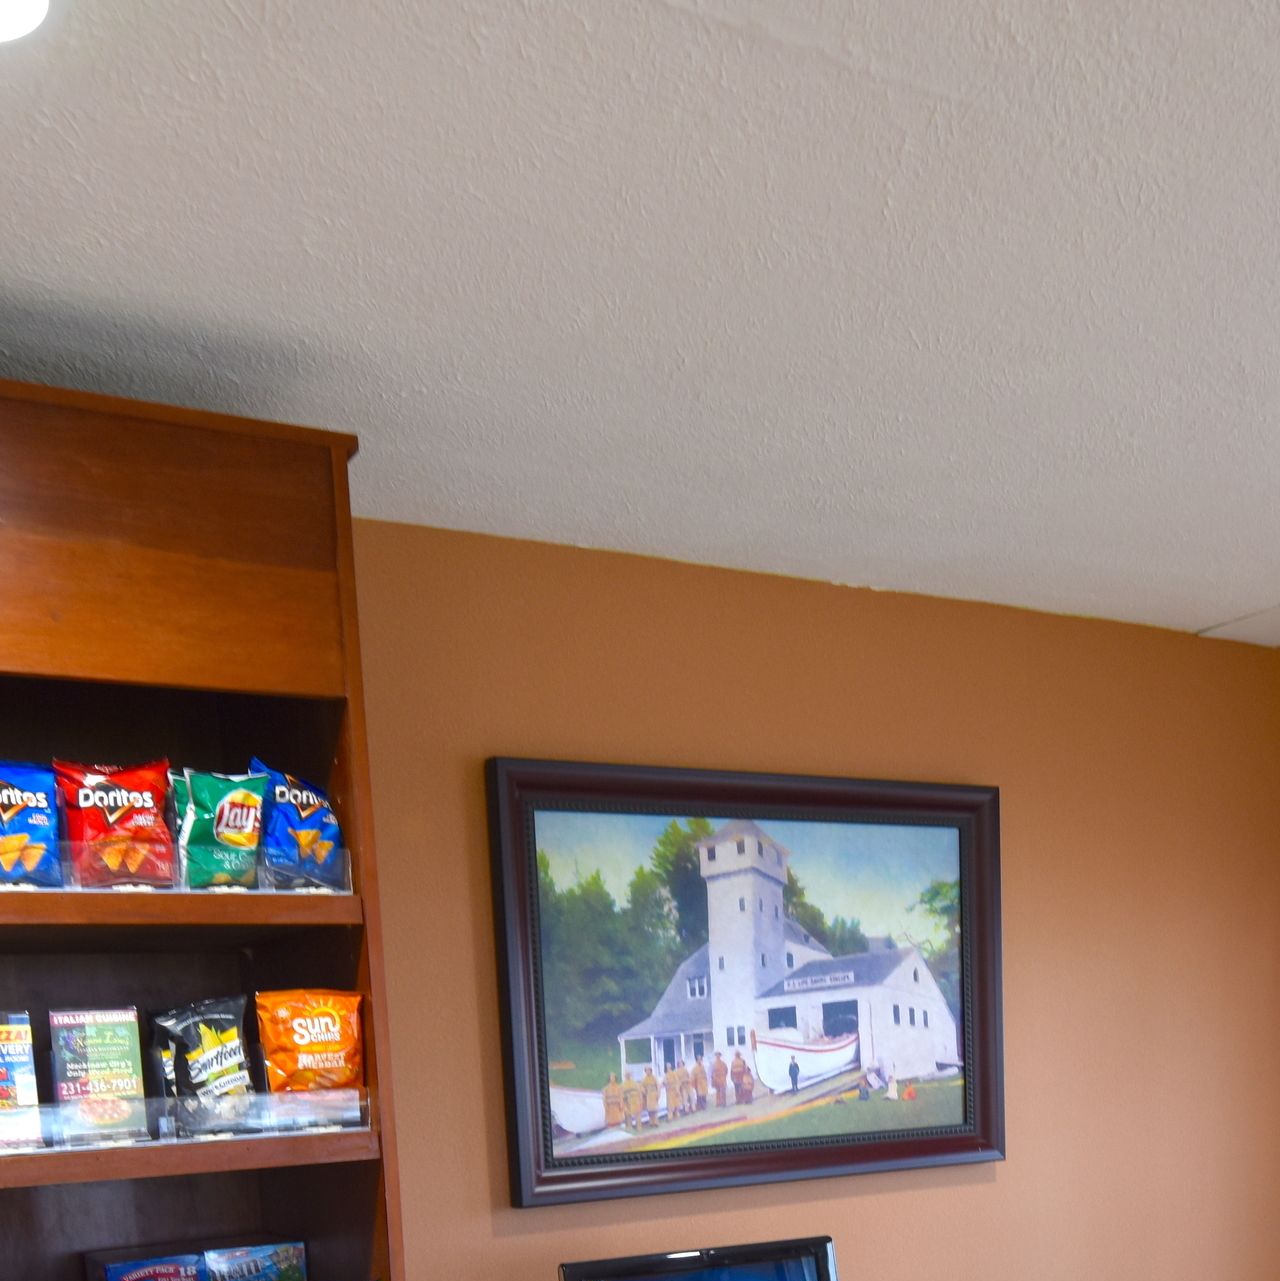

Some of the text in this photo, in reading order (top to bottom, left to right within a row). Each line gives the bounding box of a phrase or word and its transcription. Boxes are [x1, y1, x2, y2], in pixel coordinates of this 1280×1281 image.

[78, 787, 155, 809] Doritos
[53, 1014, 95, 1025] ITALIAN
[291, 1016, 342, 1046] Sun
[61, 1077, 138, 1096] 231-436-7901
